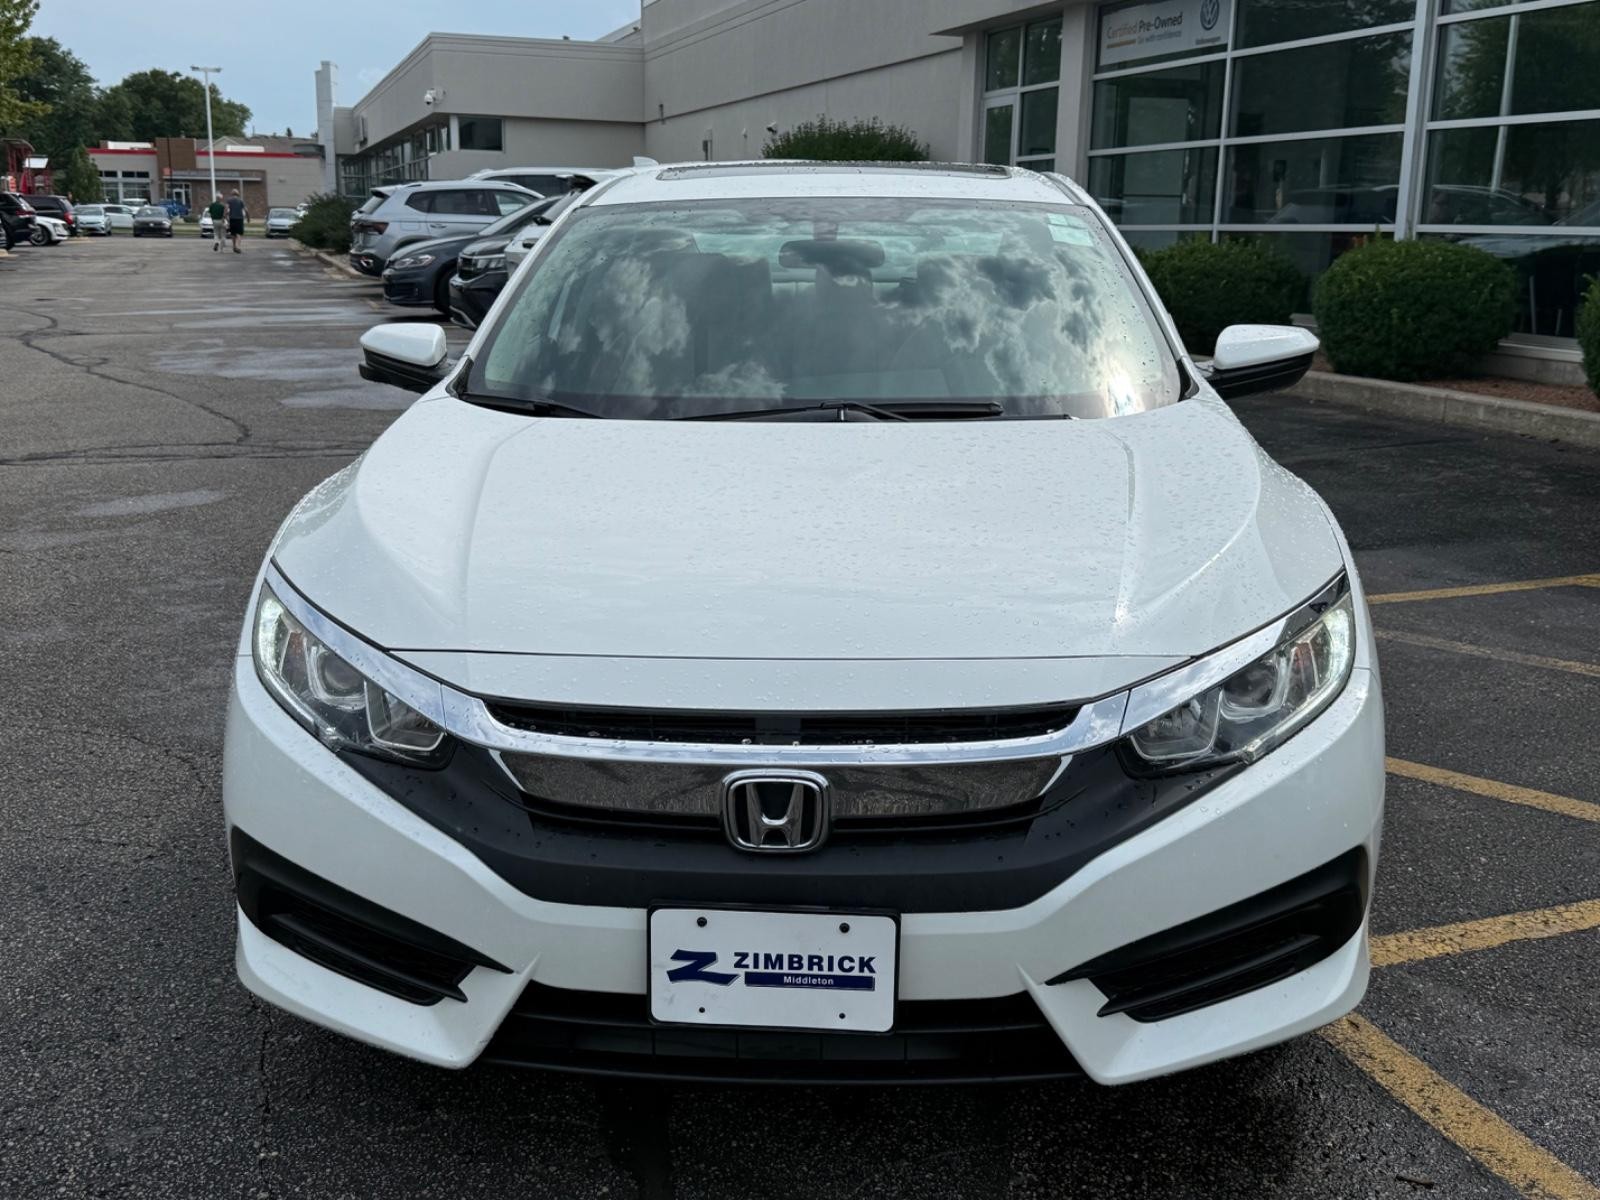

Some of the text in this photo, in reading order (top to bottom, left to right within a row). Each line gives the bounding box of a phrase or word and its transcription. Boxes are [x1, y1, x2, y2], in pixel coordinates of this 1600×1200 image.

[1139, 12, 1183, 32] Pre-Owned
[733, 951, 876, 974] ZIMBRICK
[783, 975, 834, 986] Middleton
